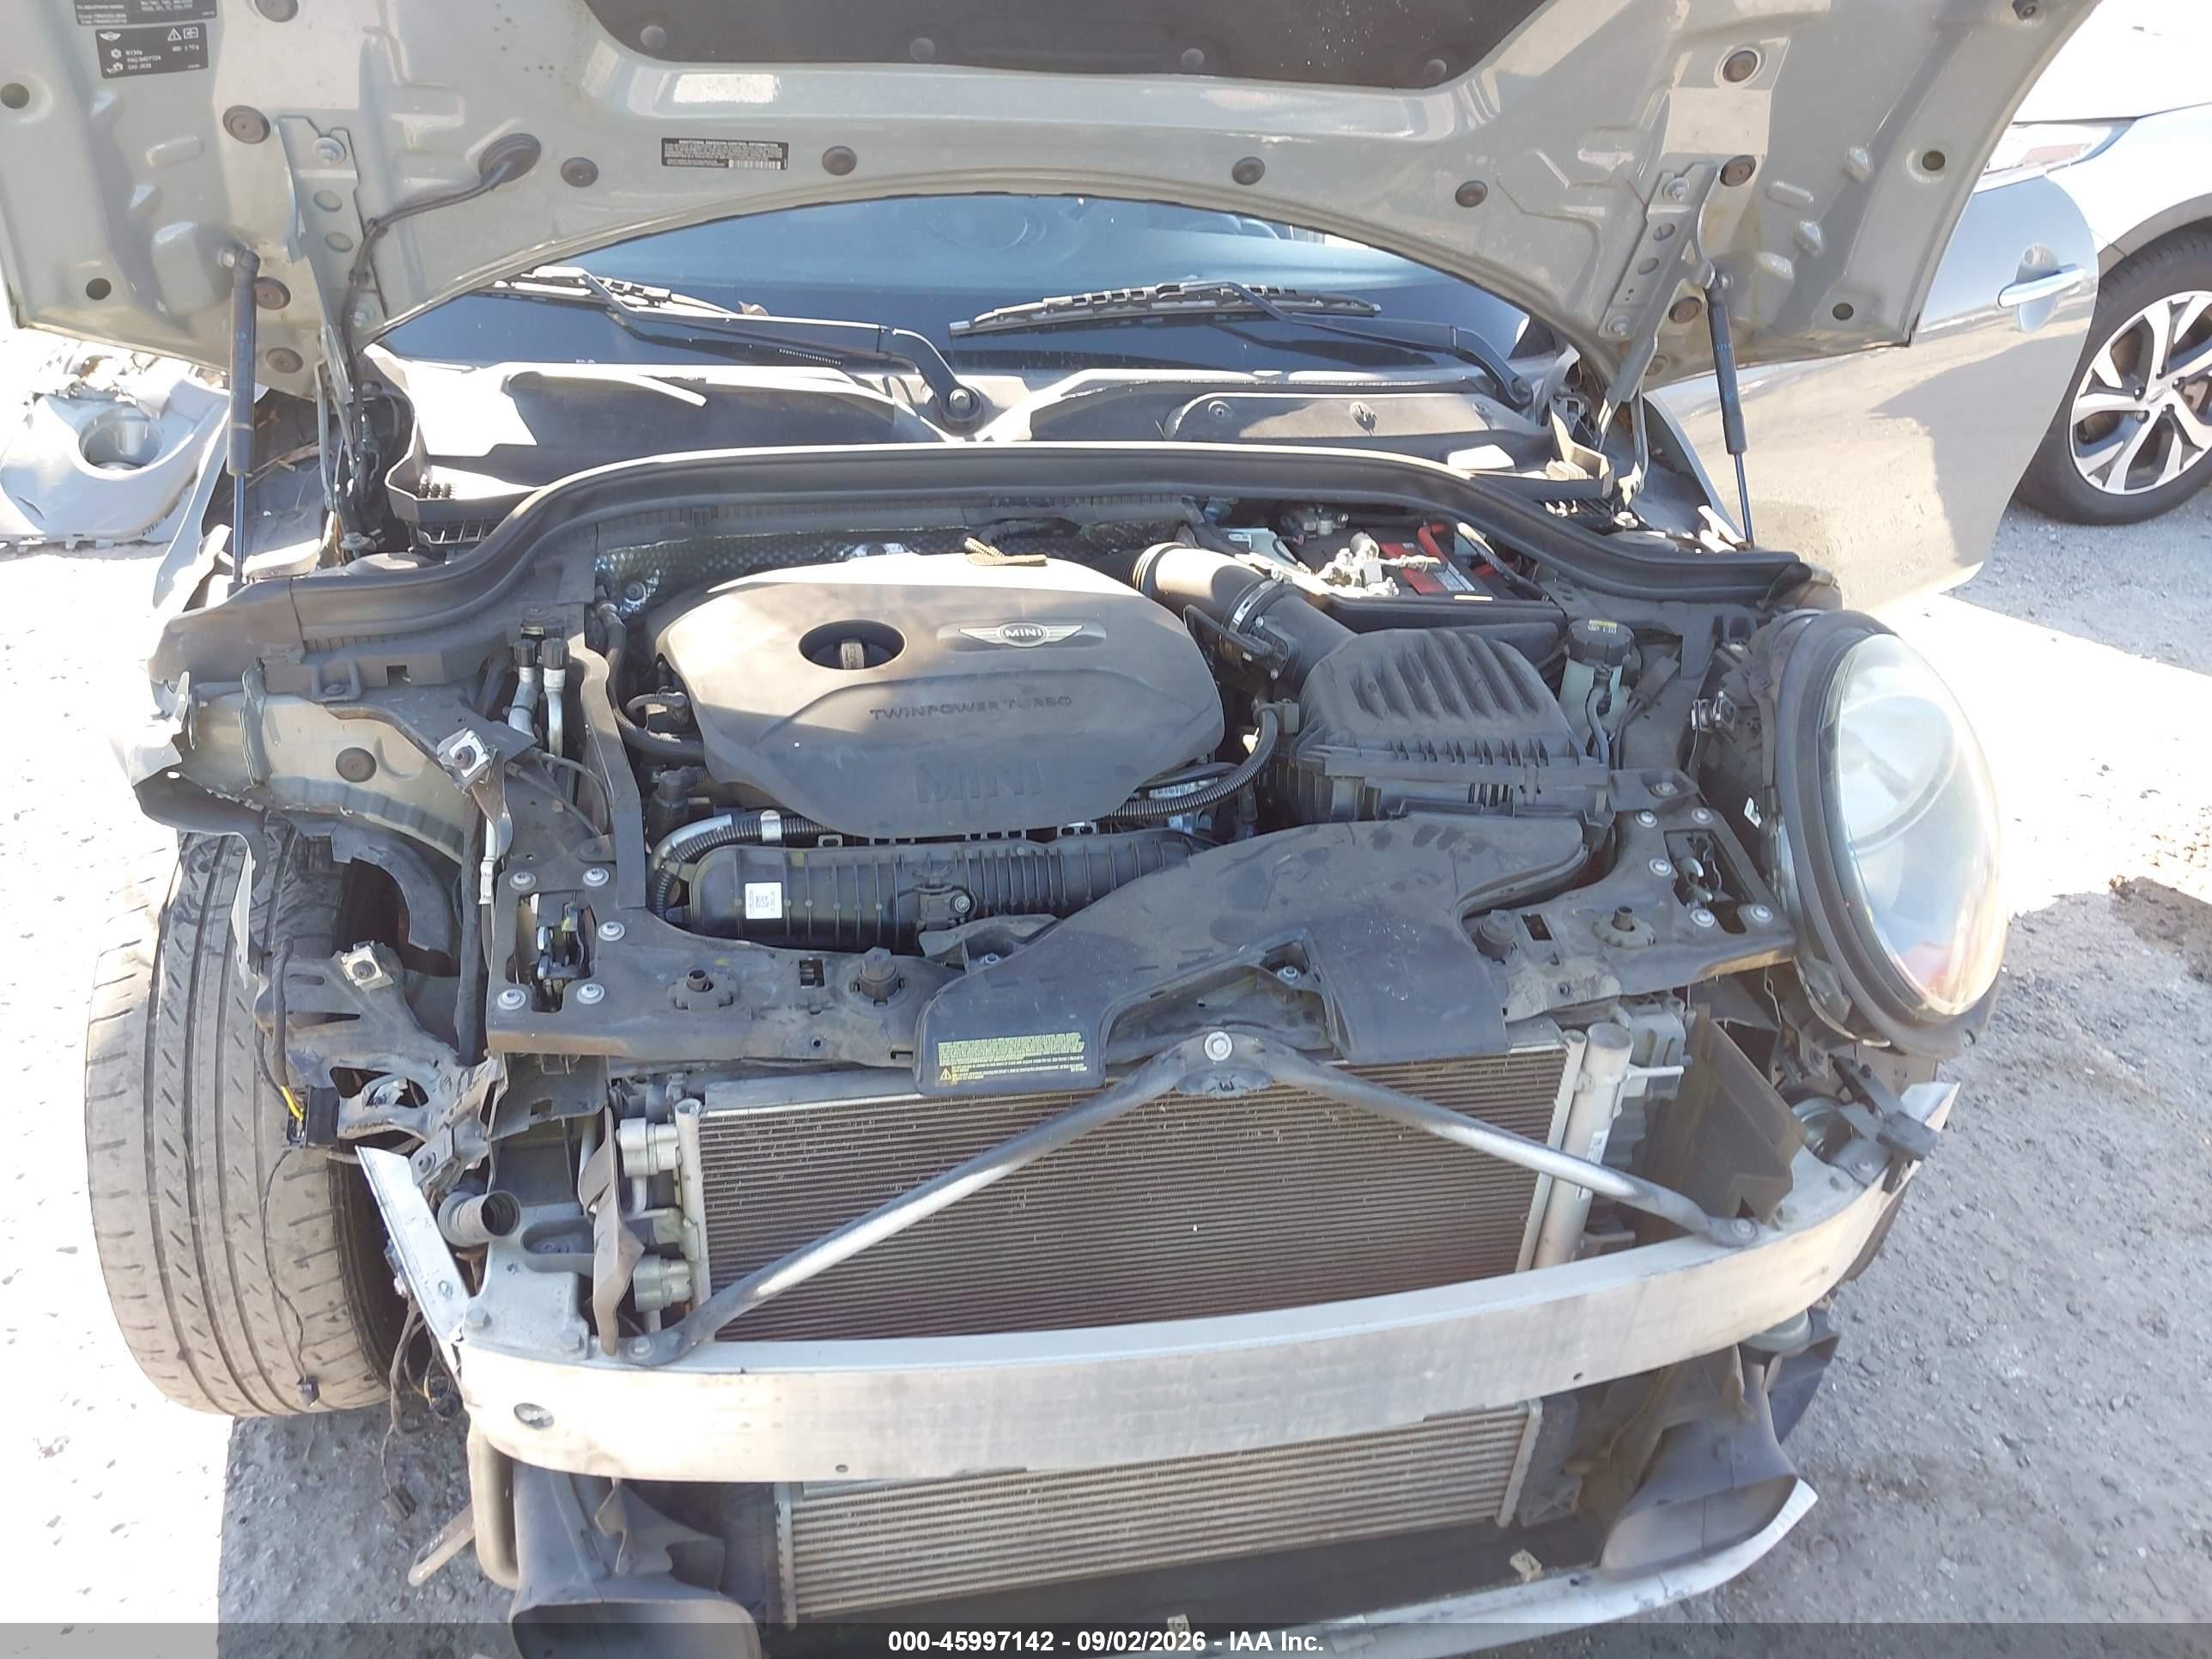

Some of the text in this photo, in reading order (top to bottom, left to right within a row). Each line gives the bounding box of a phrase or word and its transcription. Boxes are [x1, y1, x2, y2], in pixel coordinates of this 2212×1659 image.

[1004, 628, 1042, 637] MINI
[870, 696, 1073, 720] TWINPOWER TURBO
[913, 758, 1042, 804] MINI
